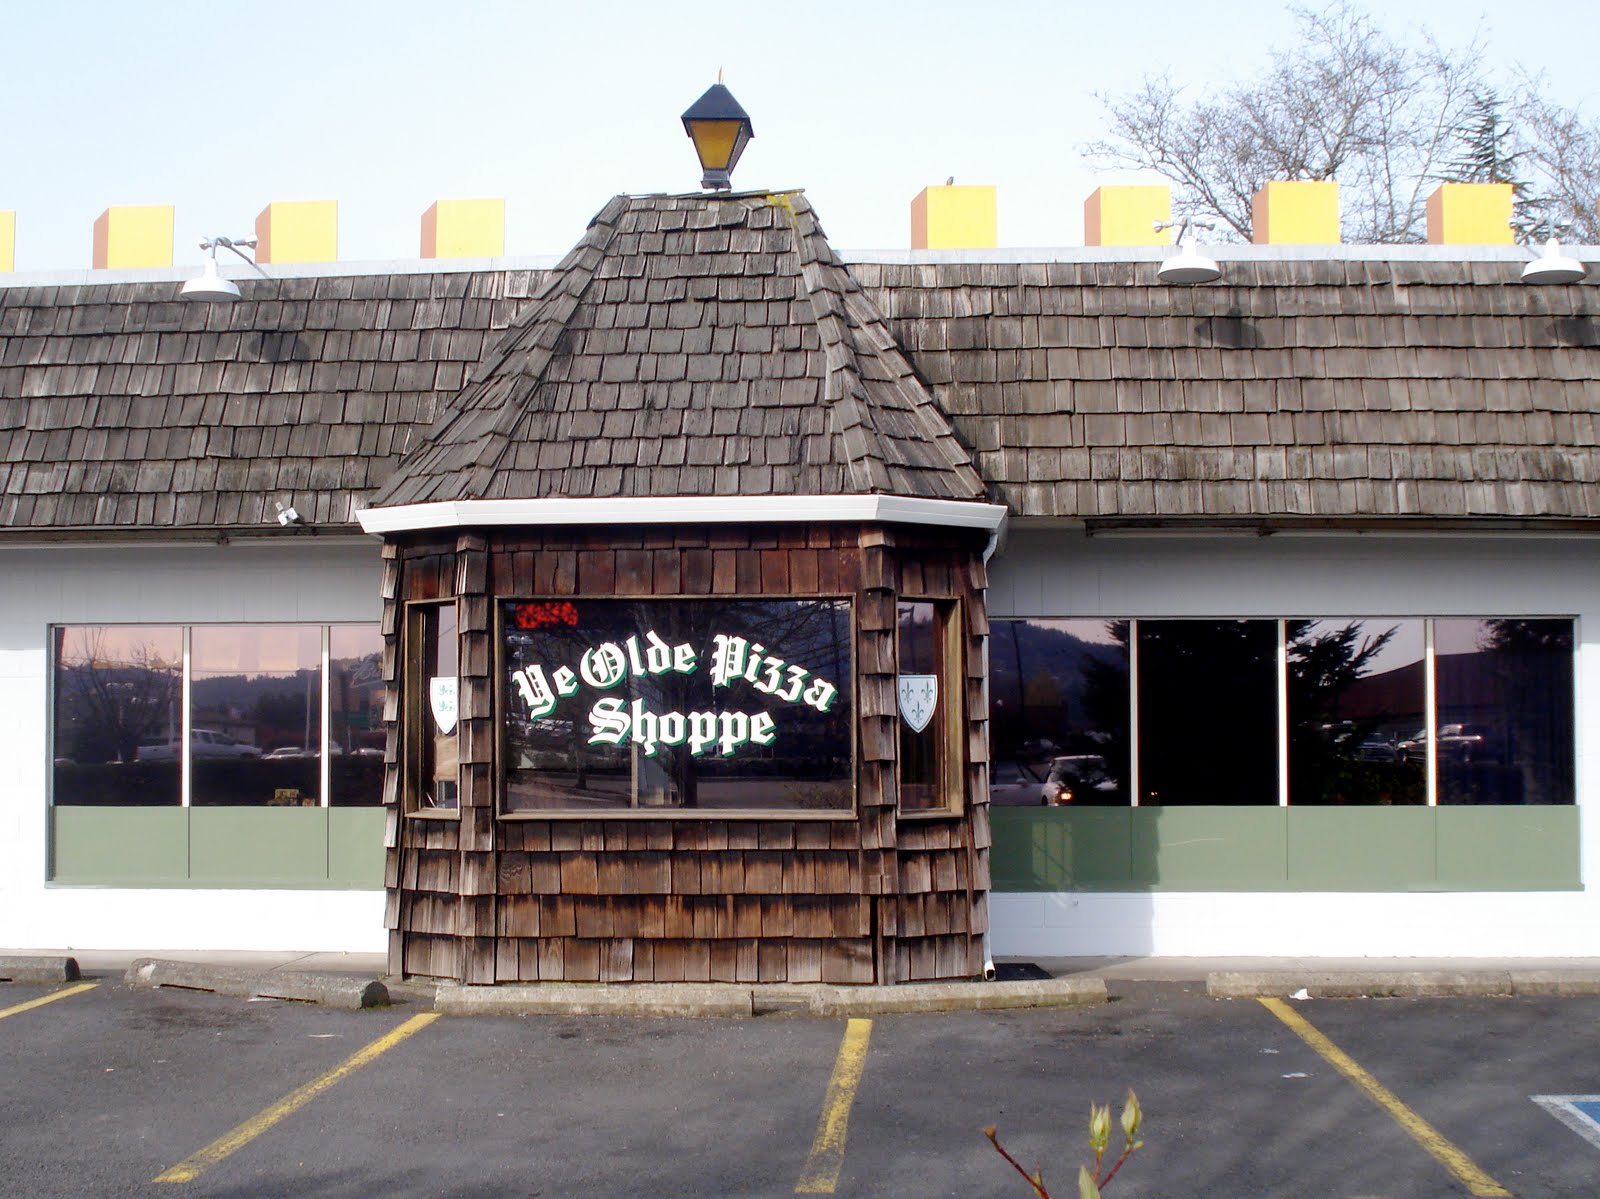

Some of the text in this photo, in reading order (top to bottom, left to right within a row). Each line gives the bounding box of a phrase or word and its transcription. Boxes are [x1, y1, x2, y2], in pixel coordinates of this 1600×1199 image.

[512, 631, 838, 721] Ye Olde Pizza
[587, 697, 776, 758] Shoppe
